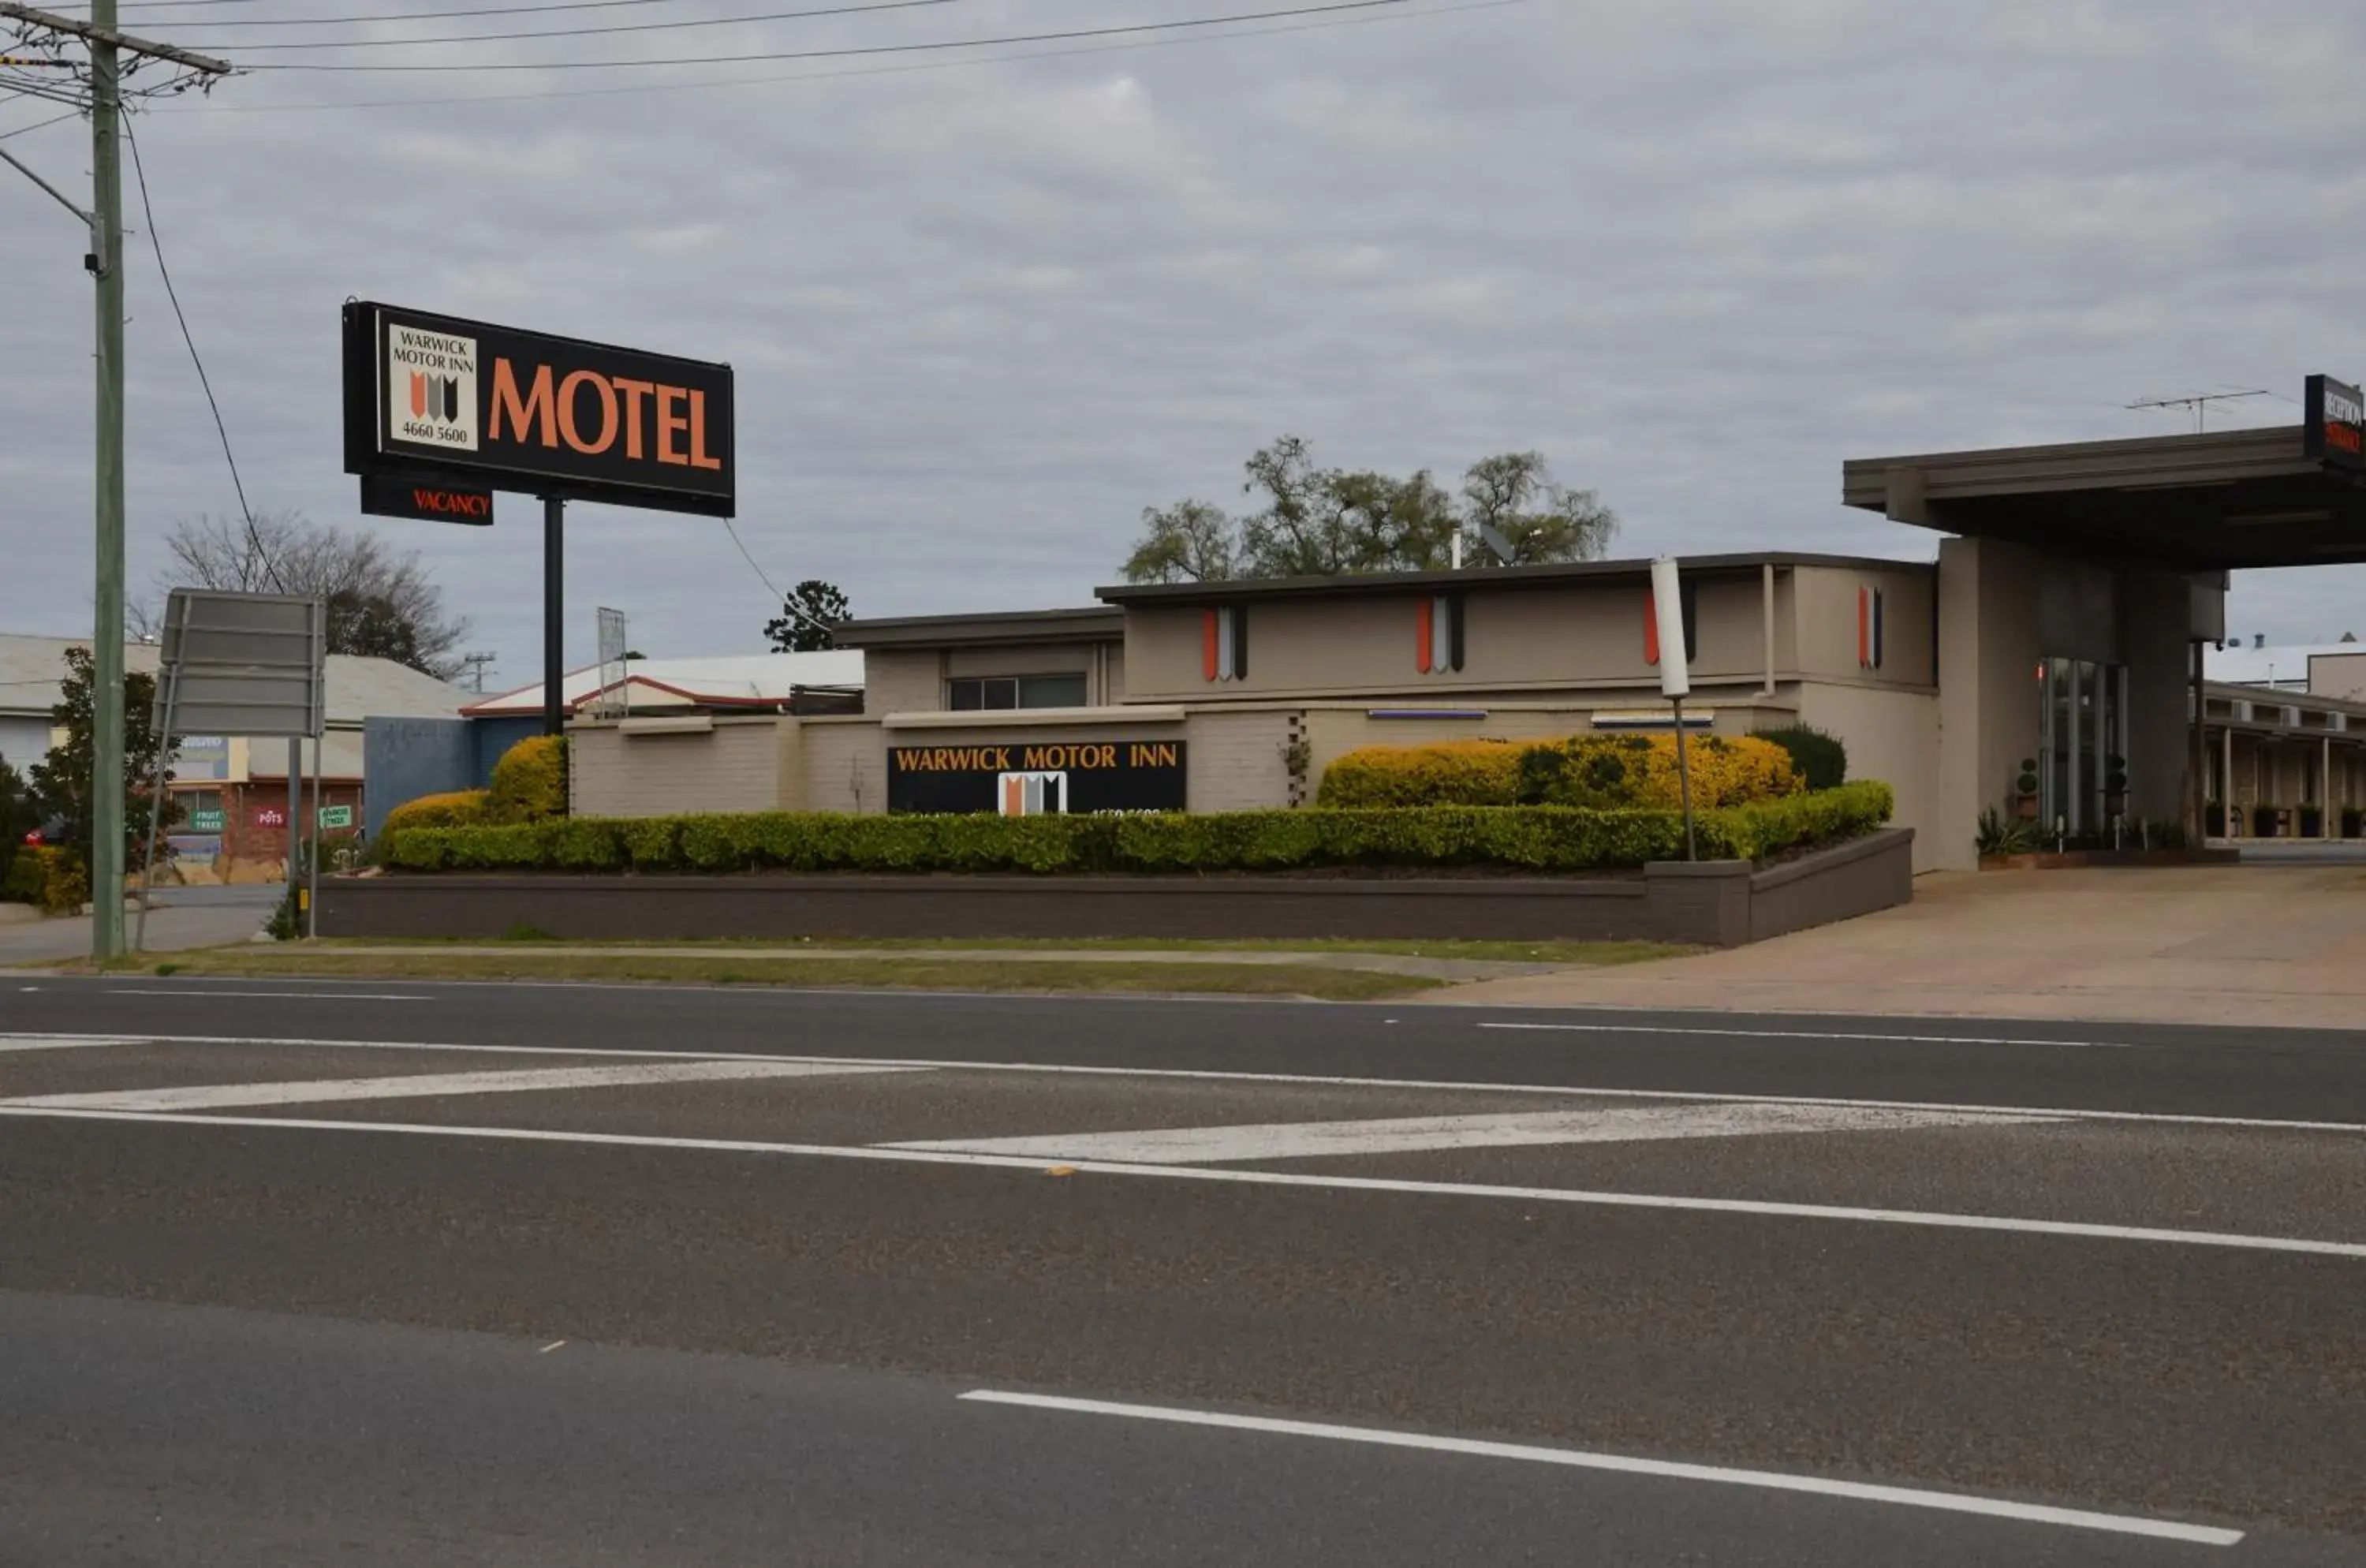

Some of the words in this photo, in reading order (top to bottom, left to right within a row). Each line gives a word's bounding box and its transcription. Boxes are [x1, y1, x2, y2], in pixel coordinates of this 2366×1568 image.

[400, 330, 467, 356] WARWICK
[394, 348, 446, 369] MOTOR
[450, 357, 474, 373] INN
[488, 357, 721, 470] MOTEL
[403, 422, 434, 439] 4660
[437, 426, 468, 443] 5600
[413, 488, 491, 517] VACANCY
[896, 747, 1010, 771] WARWICK
[1025, 745, 1116, 769] MOTOR
[1130, 744, 1177, 767] INN
[259, 812, 283, 824] POTS
